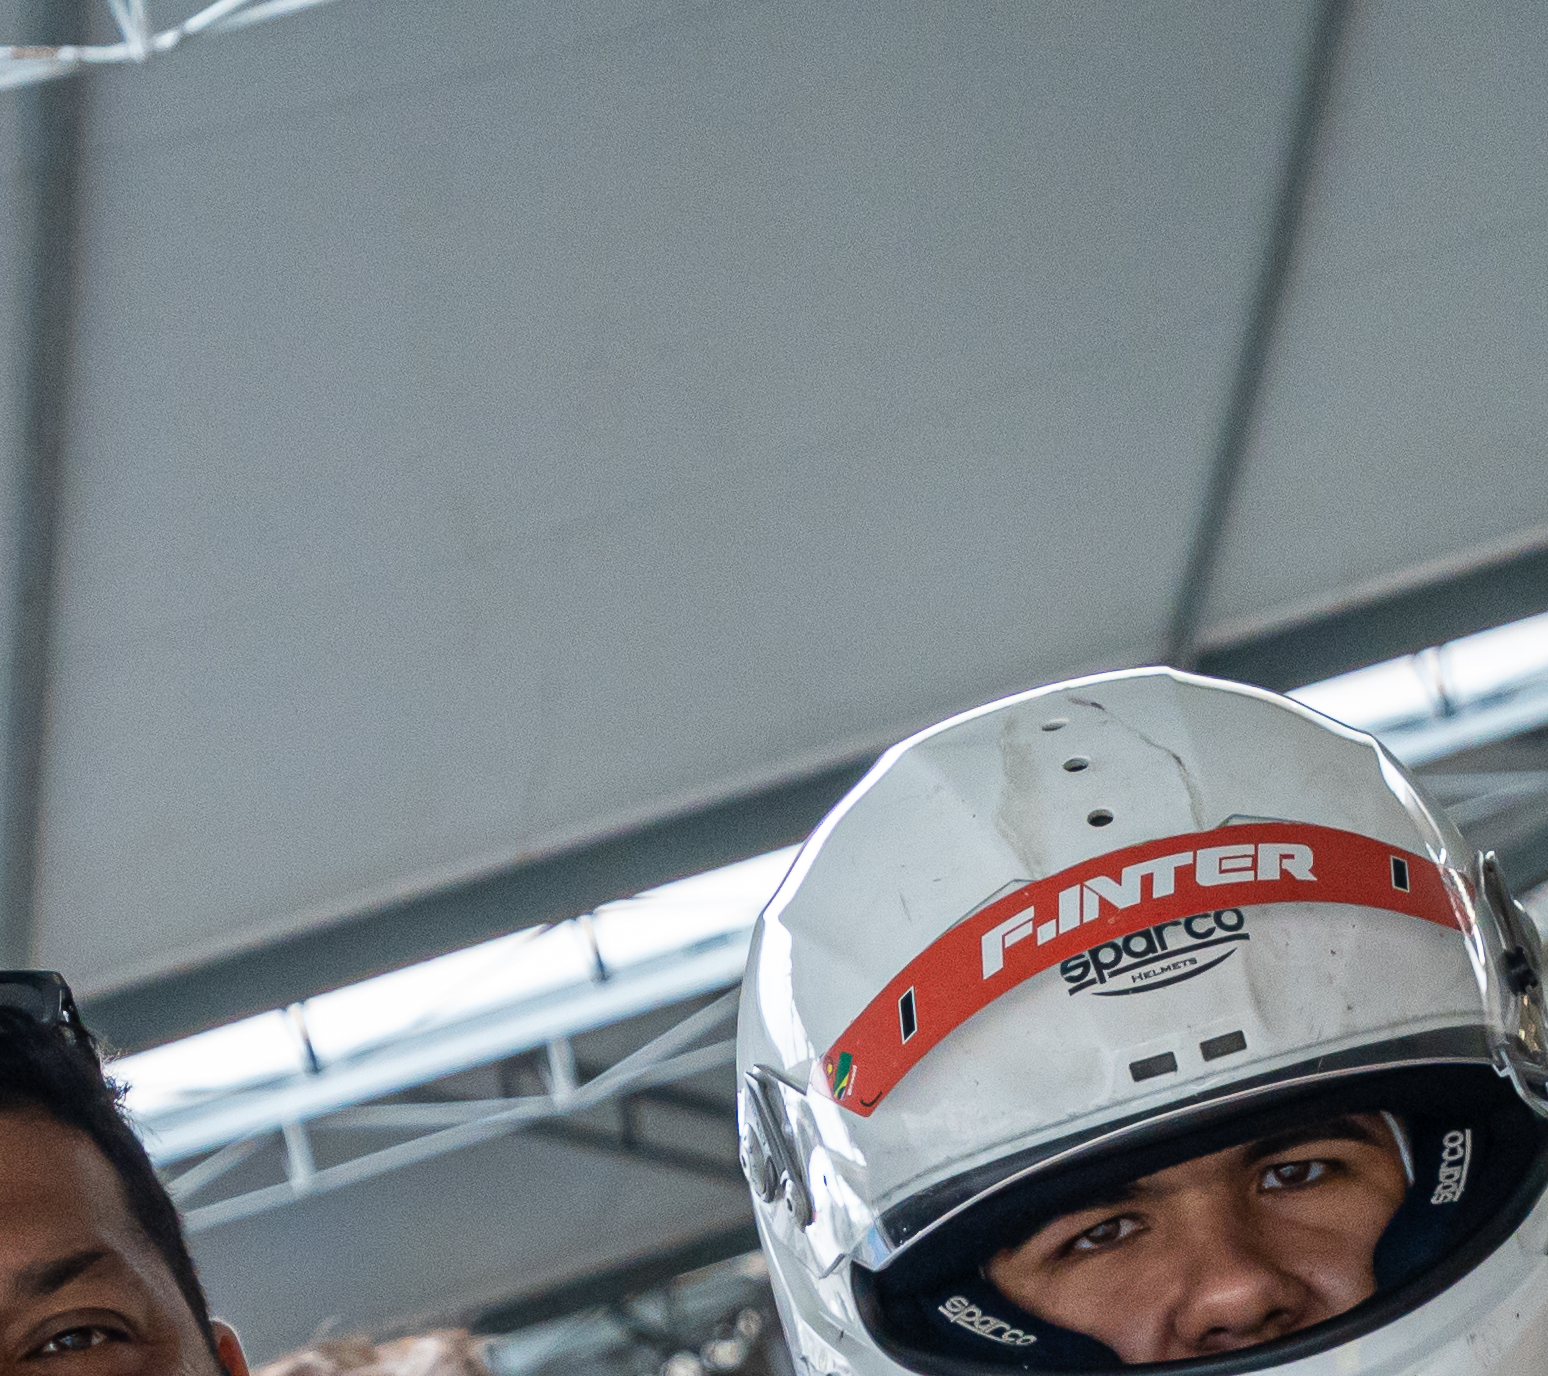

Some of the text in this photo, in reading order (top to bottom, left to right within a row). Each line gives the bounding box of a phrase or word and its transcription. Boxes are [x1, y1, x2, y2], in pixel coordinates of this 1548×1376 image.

[981, 843, 1318, 981] F.INTER
[1059, 908, 1245, 985] sparco
[1431, 1129, 1465, 1206] sparco
[937, 1295, 1037, 1346] sparco
